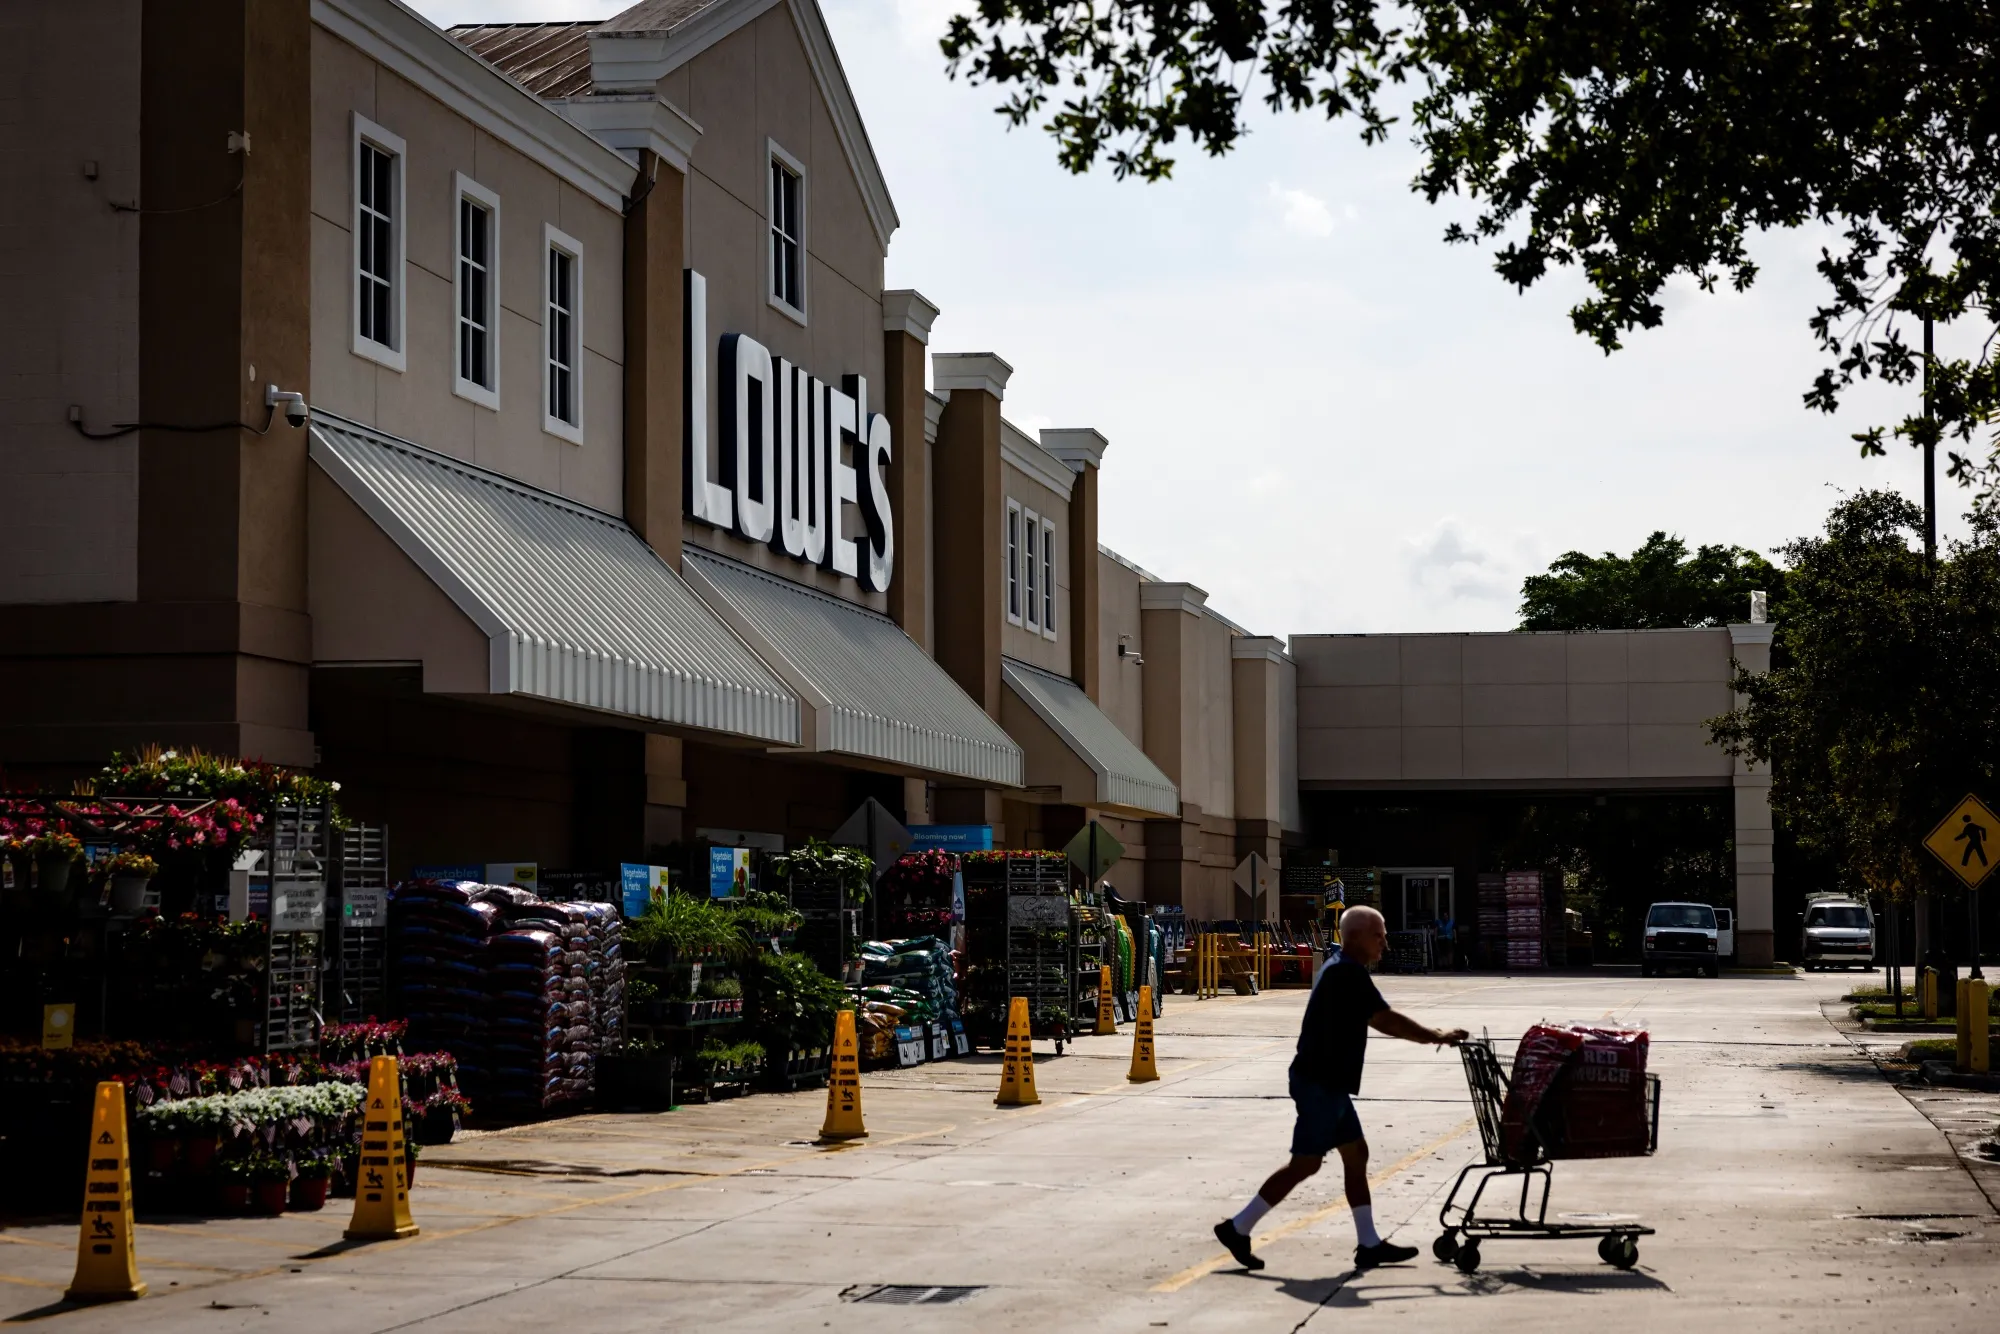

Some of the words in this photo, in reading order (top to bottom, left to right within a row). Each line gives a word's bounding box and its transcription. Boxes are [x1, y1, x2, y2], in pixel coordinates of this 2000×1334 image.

[684, 268, 894, 593] LOWE'S
[913, 832, 947, 841] Blooming
[712, 850, 732, 862] Vegetables
[623, 867, 648, 880] Vegetables
[716, 862, 727, 873] Herbs
[628, 880, 641, 892] Herbs
[1411, 879, 1429, 887] PRO
[1582, 1050, 1619, 1065] RED
[1570, 1065, 1631, 1084] MULCH
